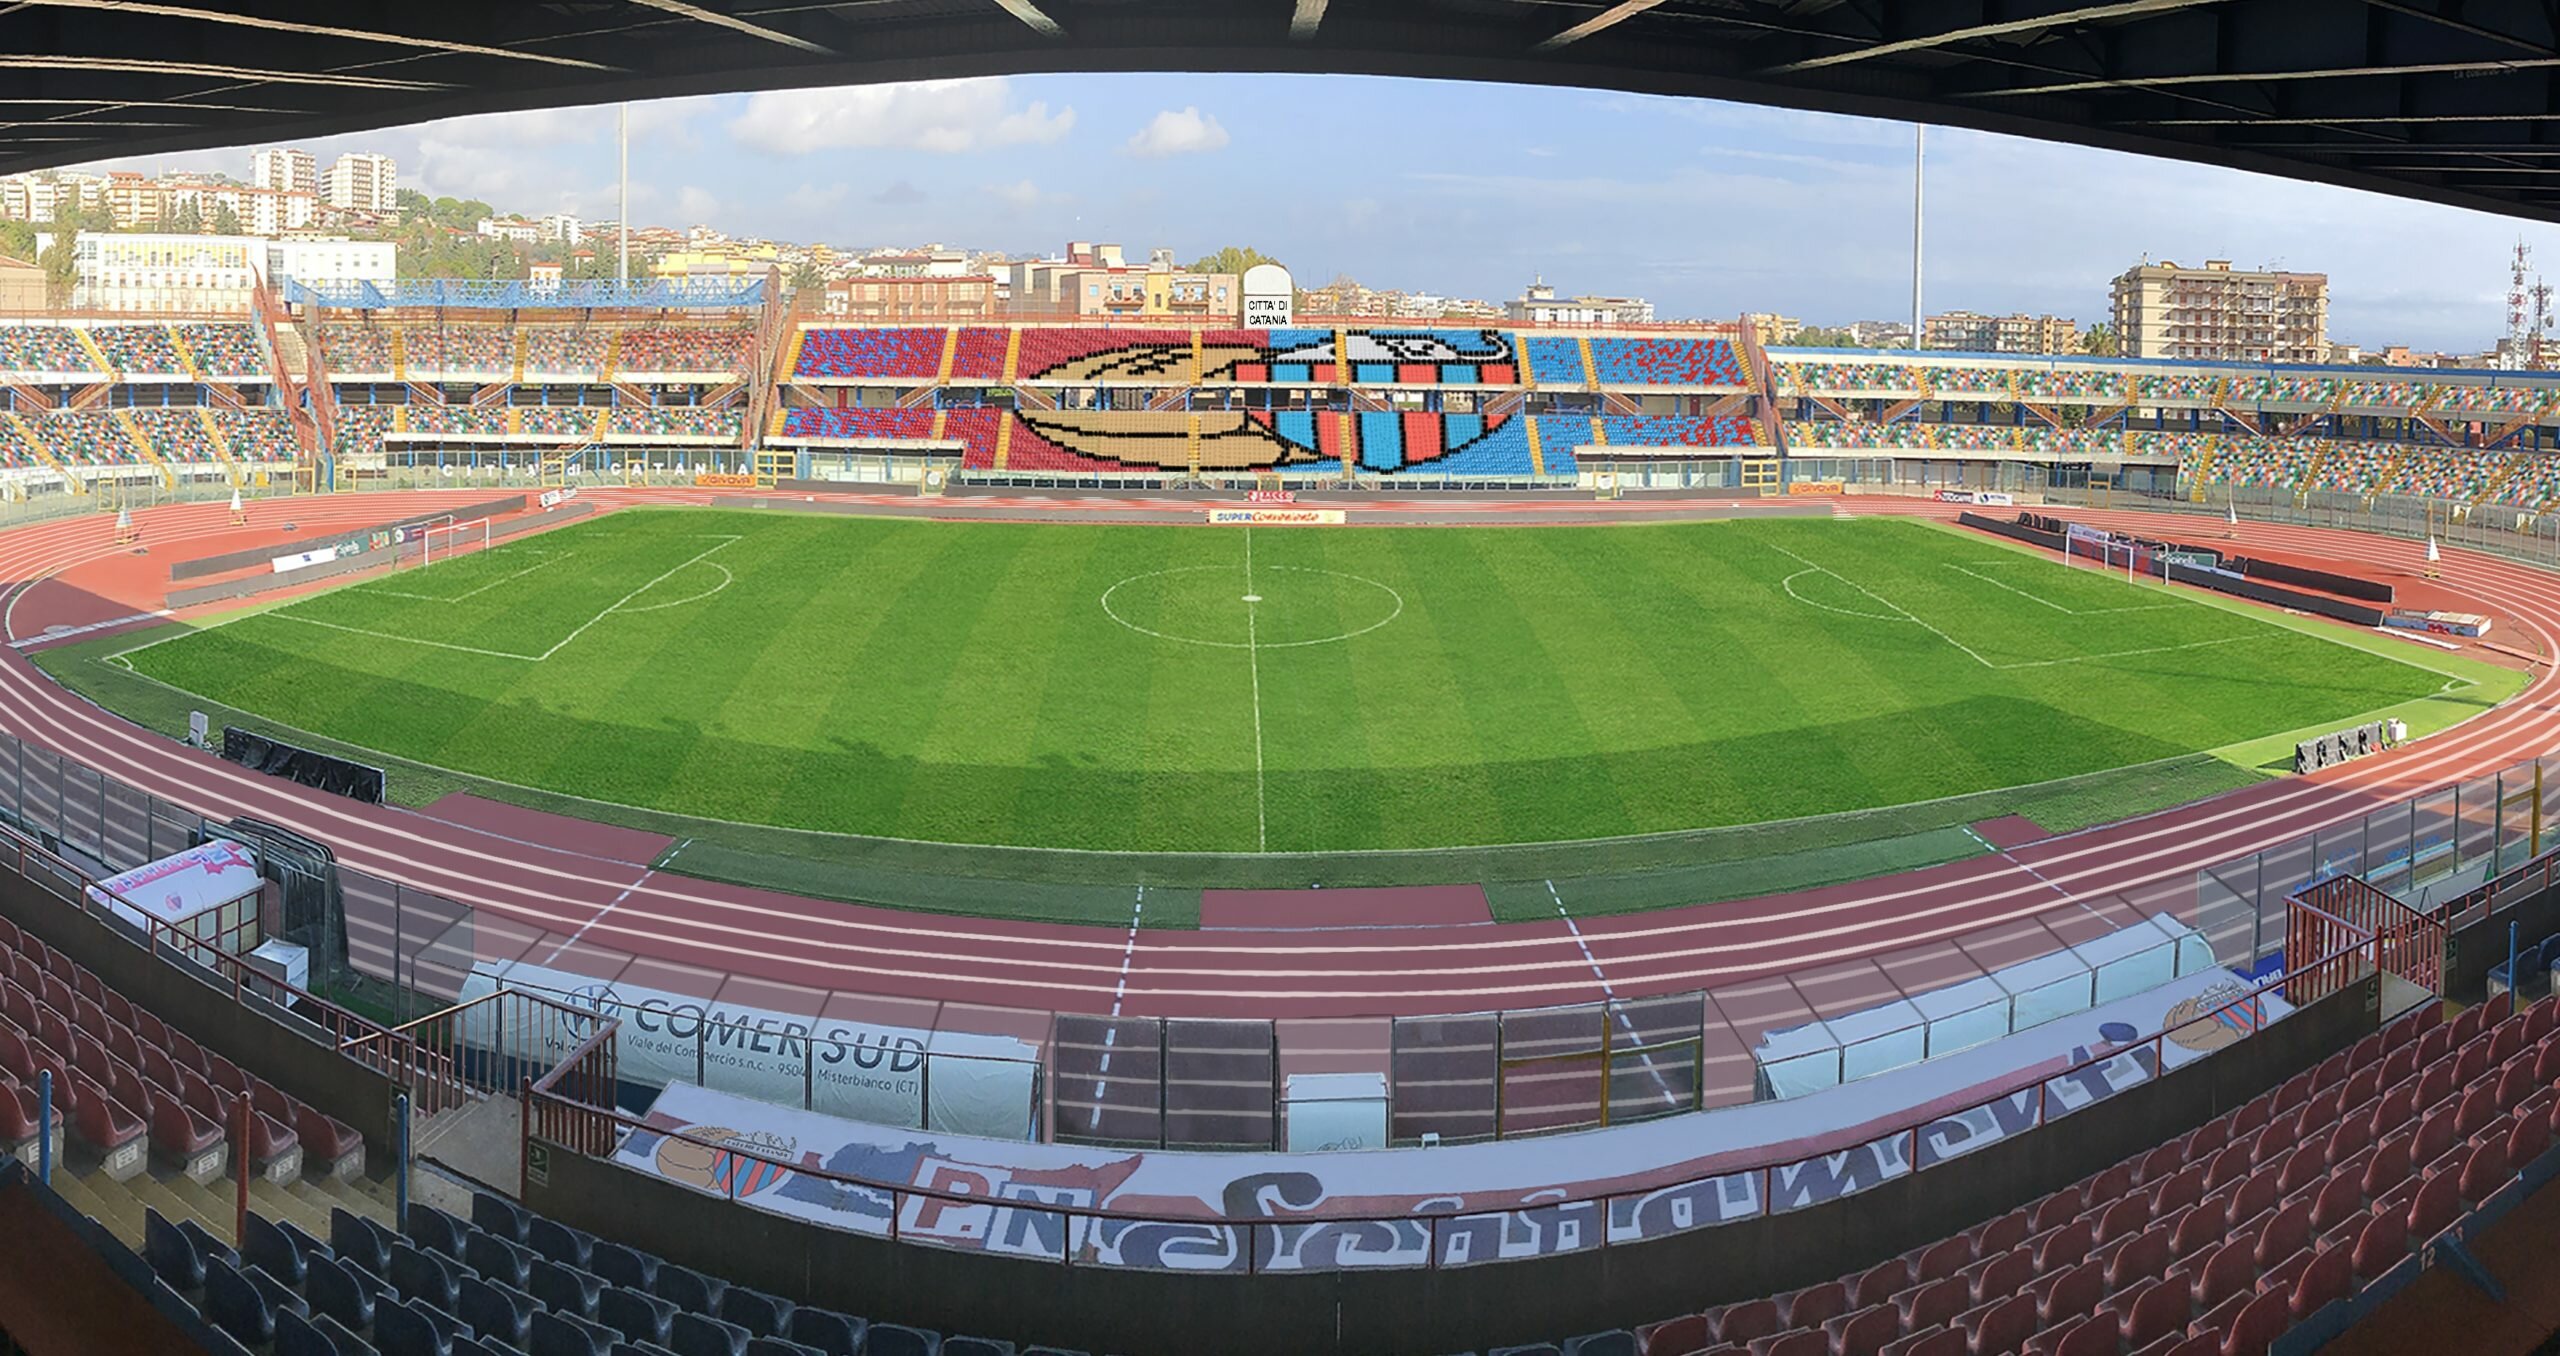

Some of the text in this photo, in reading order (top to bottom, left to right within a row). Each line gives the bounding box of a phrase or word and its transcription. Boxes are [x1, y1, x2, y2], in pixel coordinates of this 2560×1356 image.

[1249, 300, 1288, 311] CITTA' DI
[1249, 315, 1288, 326] CATANIA
[567, 463, 580, 477] di
[609, 463, 750, 476] CATANIA
[635, 998, 924, 1073] COMER SUD
[628, 1034, 654, 1050] Viale
[656, 1041, 672, 1054] del
[778, 1062, 806, 1077] 9504
[817, 1068, 892, 1091] Misterbianco
[896, 1080, 919, 1096] (CT)
